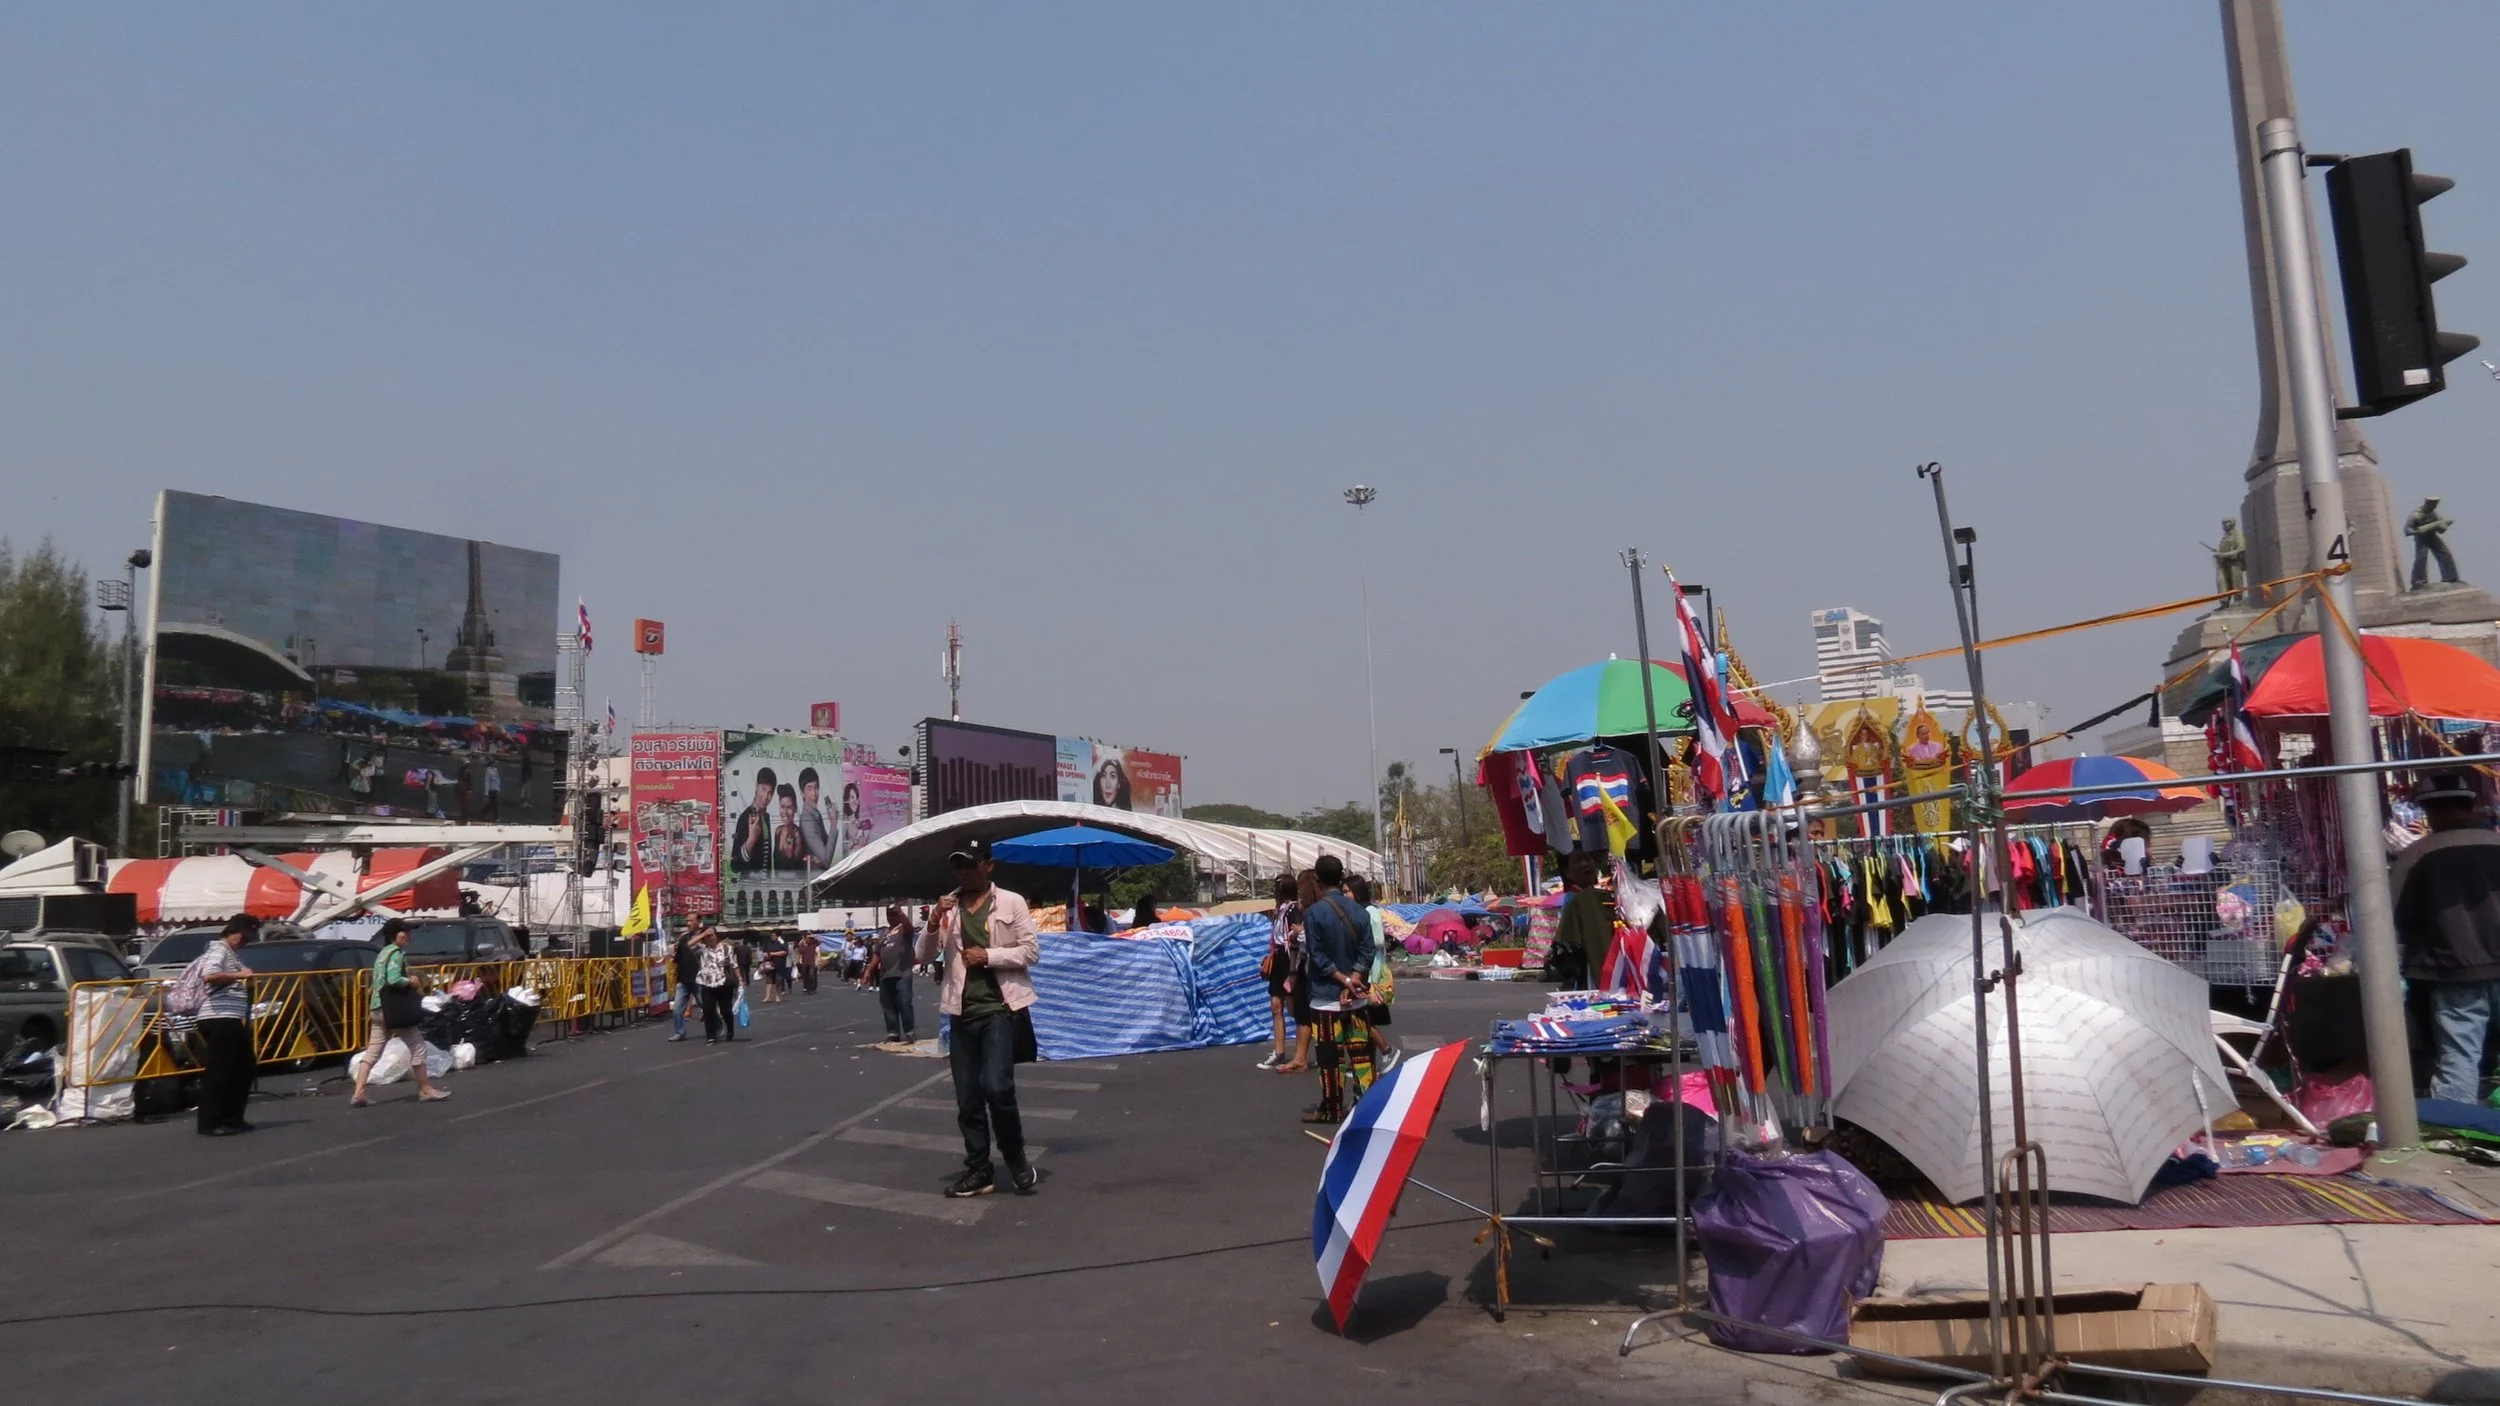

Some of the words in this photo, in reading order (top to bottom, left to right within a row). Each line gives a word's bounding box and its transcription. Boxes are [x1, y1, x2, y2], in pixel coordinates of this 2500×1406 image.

[2327, 534, 2349, 562] 4
[634, 735, 714, 756] อนุสาวรีย์ชัย
